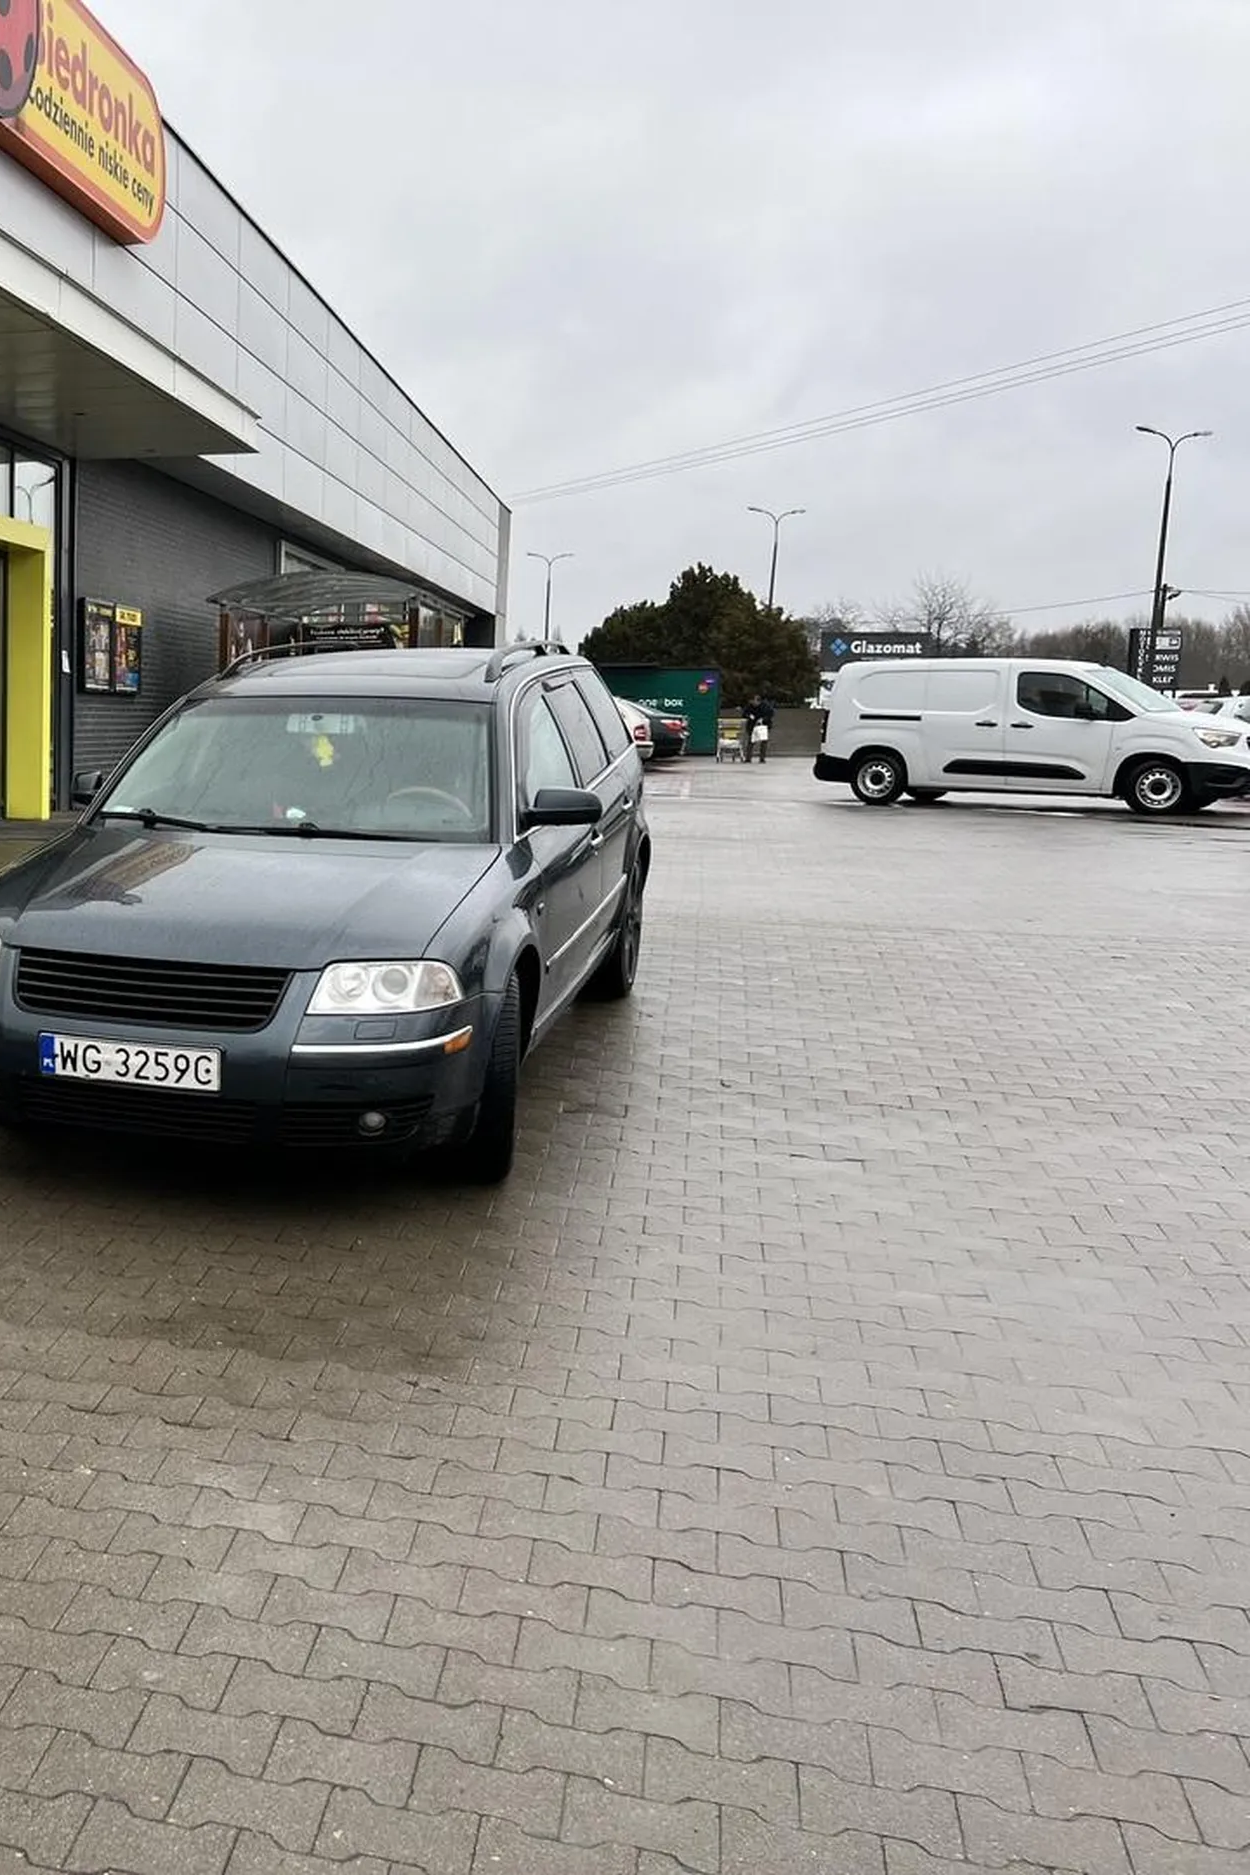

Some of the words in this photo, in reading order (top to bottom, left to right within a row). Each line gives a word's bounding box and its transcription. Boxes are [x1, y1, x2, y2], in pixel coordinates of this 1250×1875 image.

[98, 139, 129, 189] niskie
[131, 176, 155, 216] ceny
[850, 640, 923, 654] Glazomat
[664, 698, 684, 708] box
[59, 1042, 101, 1073] WG
[115, 1048, 212, 1085] 3259C
